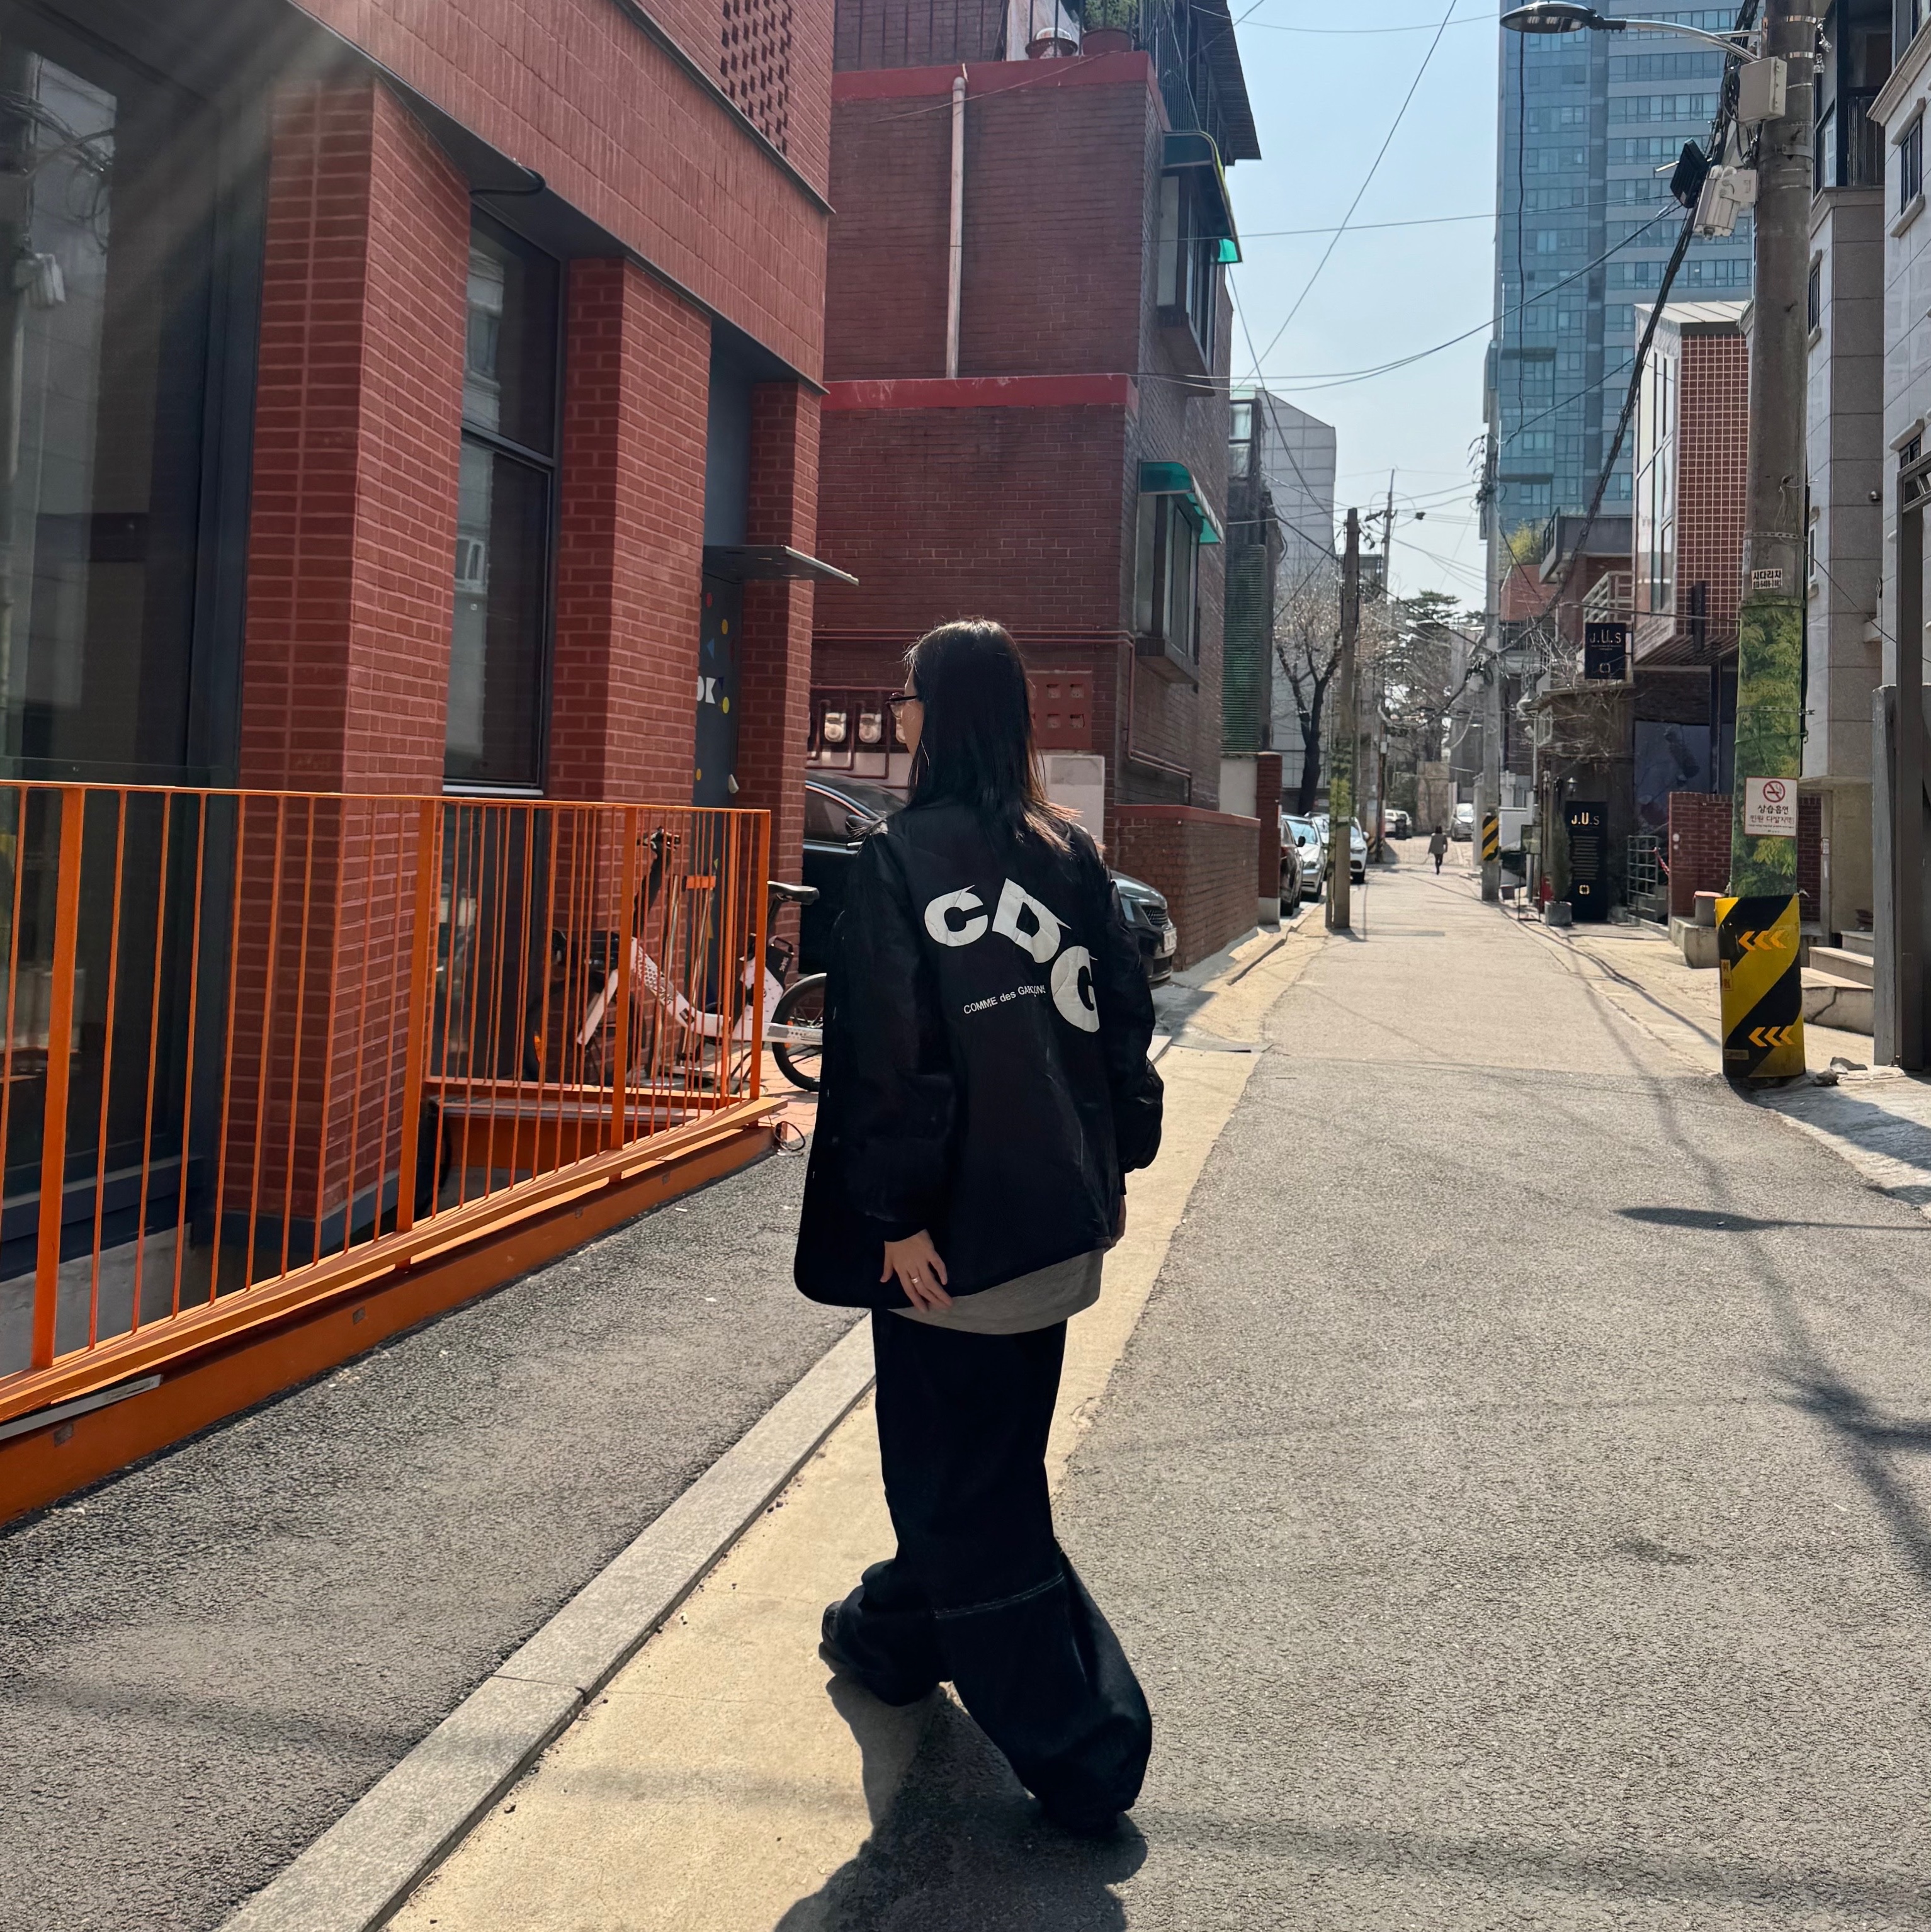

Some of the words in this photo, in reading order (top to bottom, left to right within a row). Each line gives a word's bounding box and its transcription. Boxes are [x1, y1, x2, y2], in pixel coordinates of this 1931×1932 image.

[1590, 630, 1621, 643] J.U.S
[1758, 805, 1789, 815] 상습흡연
[1571, 811, 1600, 825] J.U.S
[963, 997, 998, 1014] COMME
[999, 991, 1016, 1002] des
